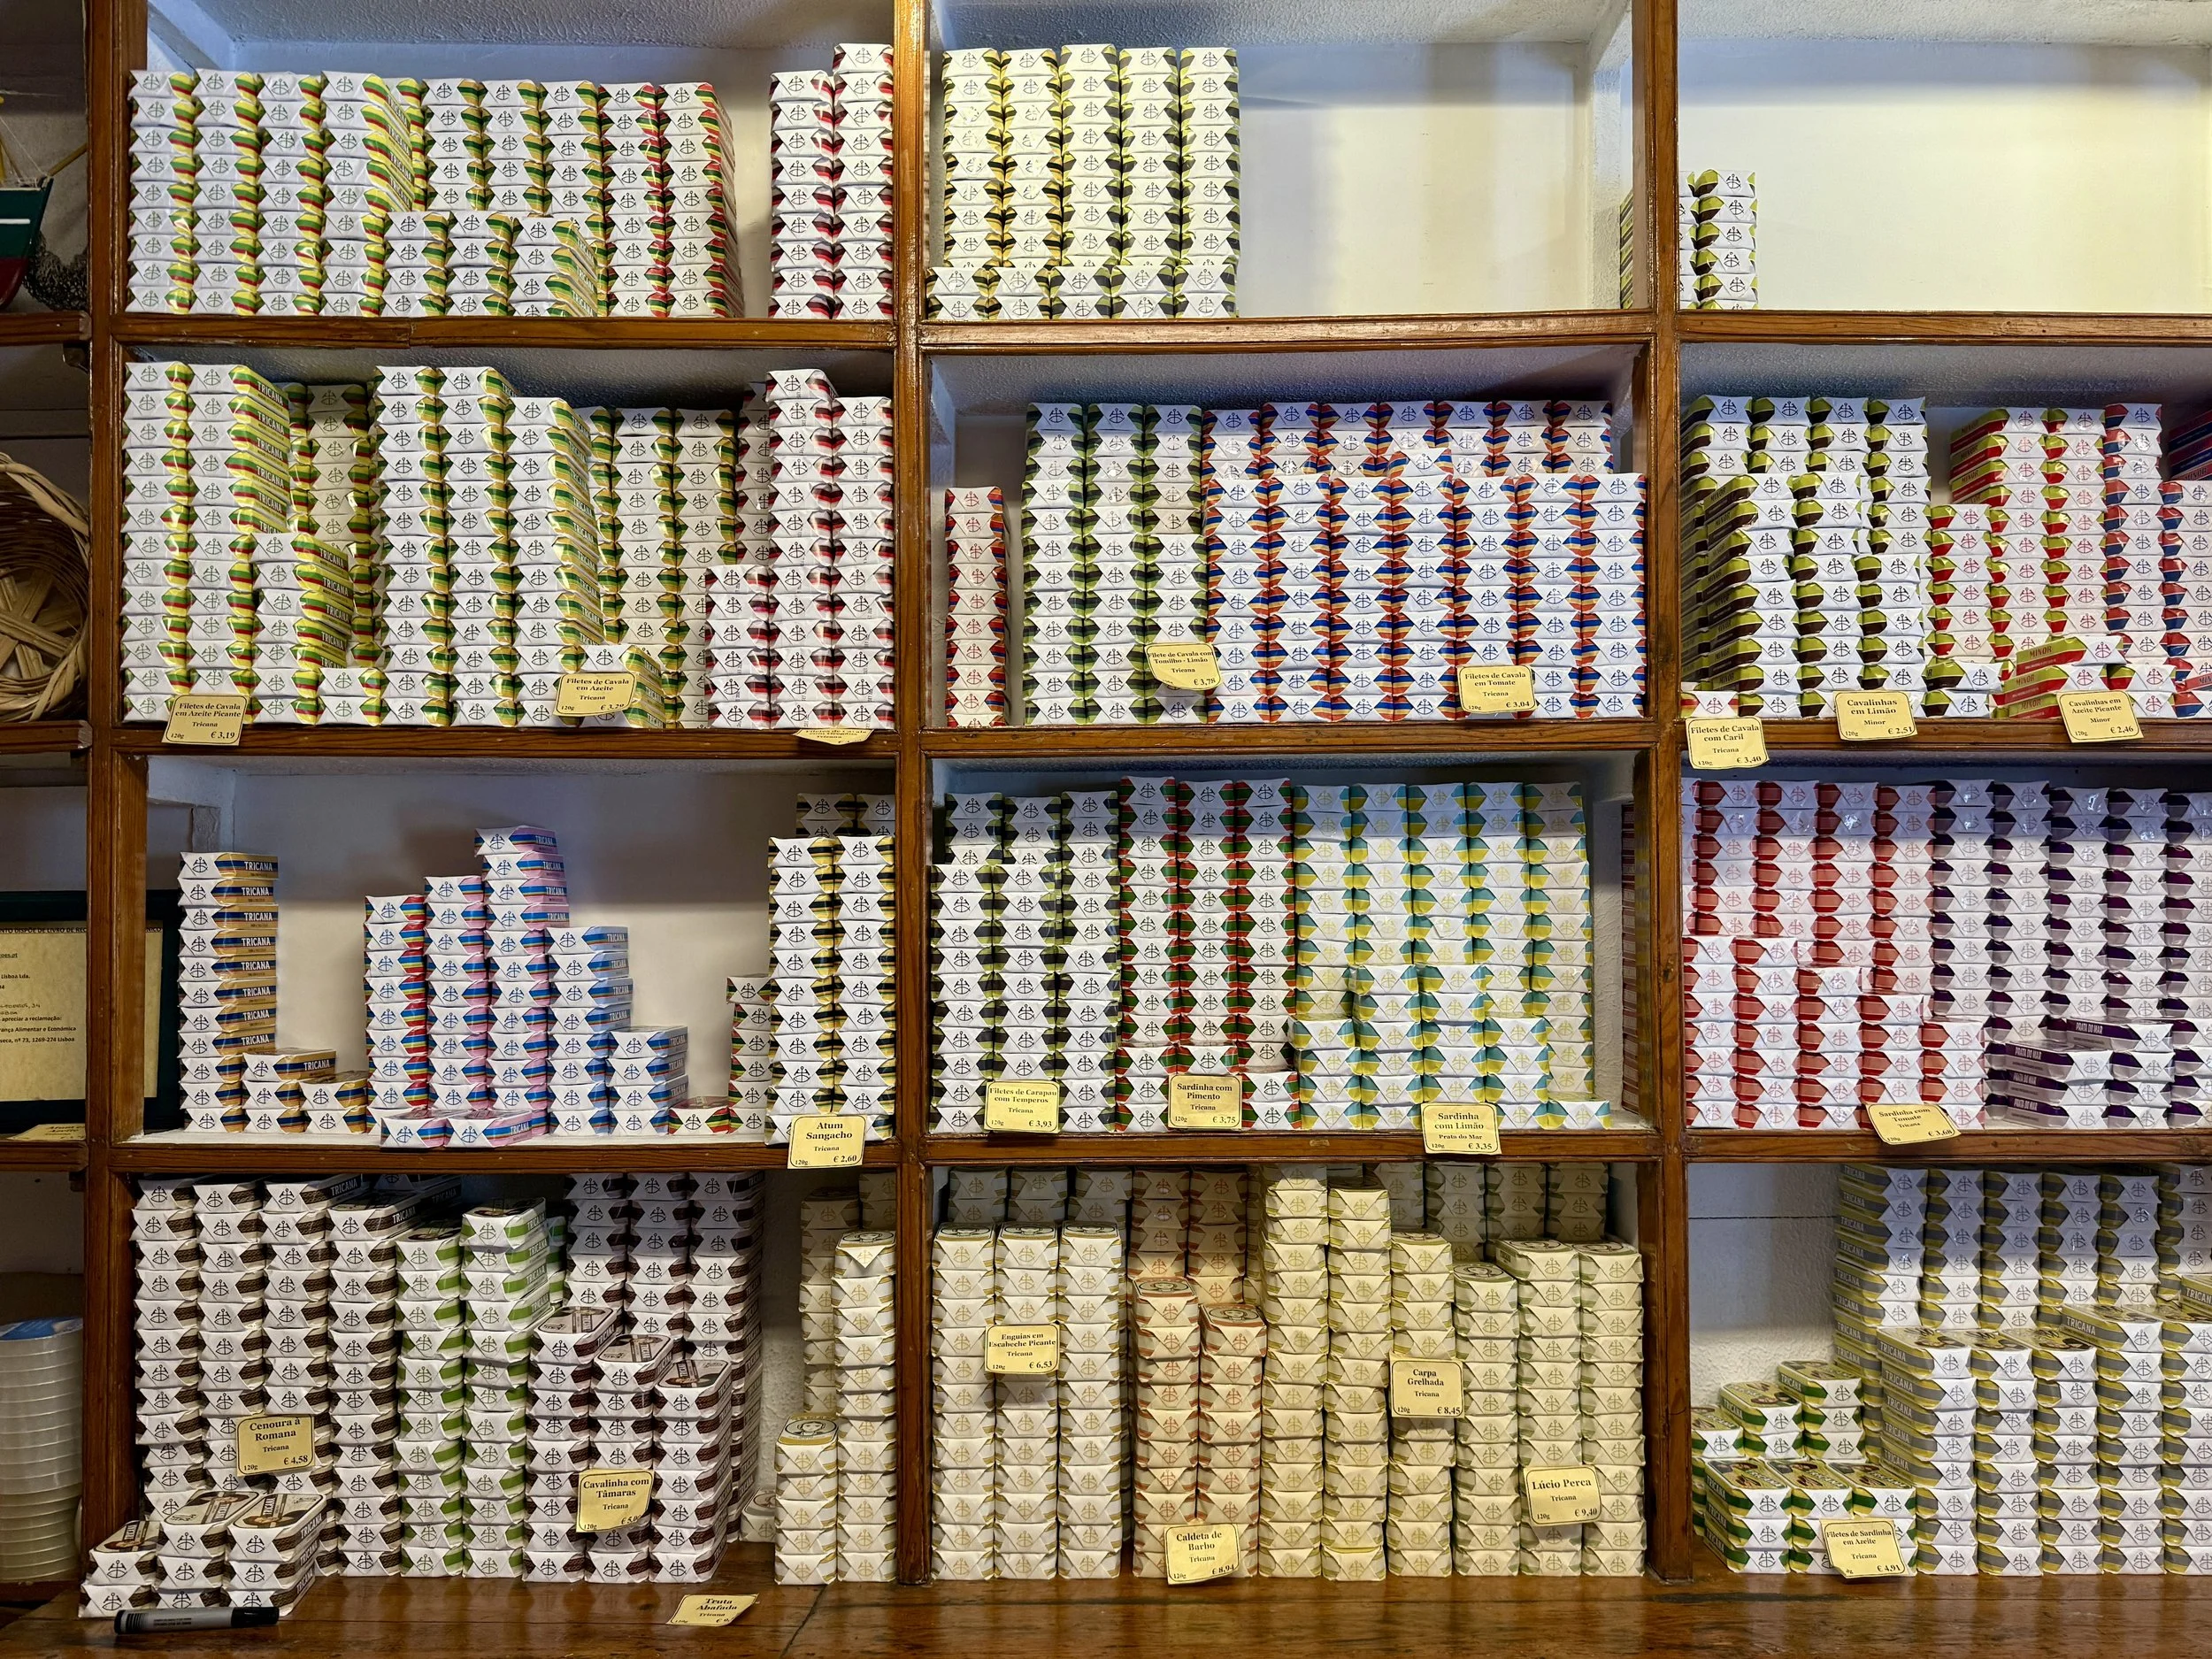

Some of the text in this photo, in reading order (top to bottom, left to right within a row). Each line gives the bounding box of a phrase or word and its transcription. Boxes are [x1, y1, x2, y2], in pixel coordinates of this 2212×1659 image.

[257, 381, 283, 405] TRICANA
[257, 438, 283, 461] TRICANA
[258, 492, 282, 513] TRICANA
[2030, 646, 2052, 657] MINOR
[242, 887, 269, 896] TRICANA
[242, 938, 271, 947] TRICANA
[242, 987, 271, 996] TRICANA
[242, 1033, 269, 1046] TRICANA
[2015, 1048, 2026, 1056] PRATA
[2032, 1049, 2042, 1060] MAR
[806, 1132, 852, 1141] Sangacho
[2067, 1317, 2096, 1335] TRICANA
[1413, 1369, 1437, 1378] Carpa
[1886, 1371, 1913, 1392] TRICANA
[250, 1420, 292, 1431] Cenoura
[256, 1430, 296, 1441] Romana
[584, 1479, 628, 1488] Cavalinha
[1532, 1479, 1592, 1489] Lúcio Perca
[596, 1489, 636, 1498] Tâmaras
[301, 1513, 322, 1539] TRICANA
[1177, 1532, 1209, 1541] Caldeta
